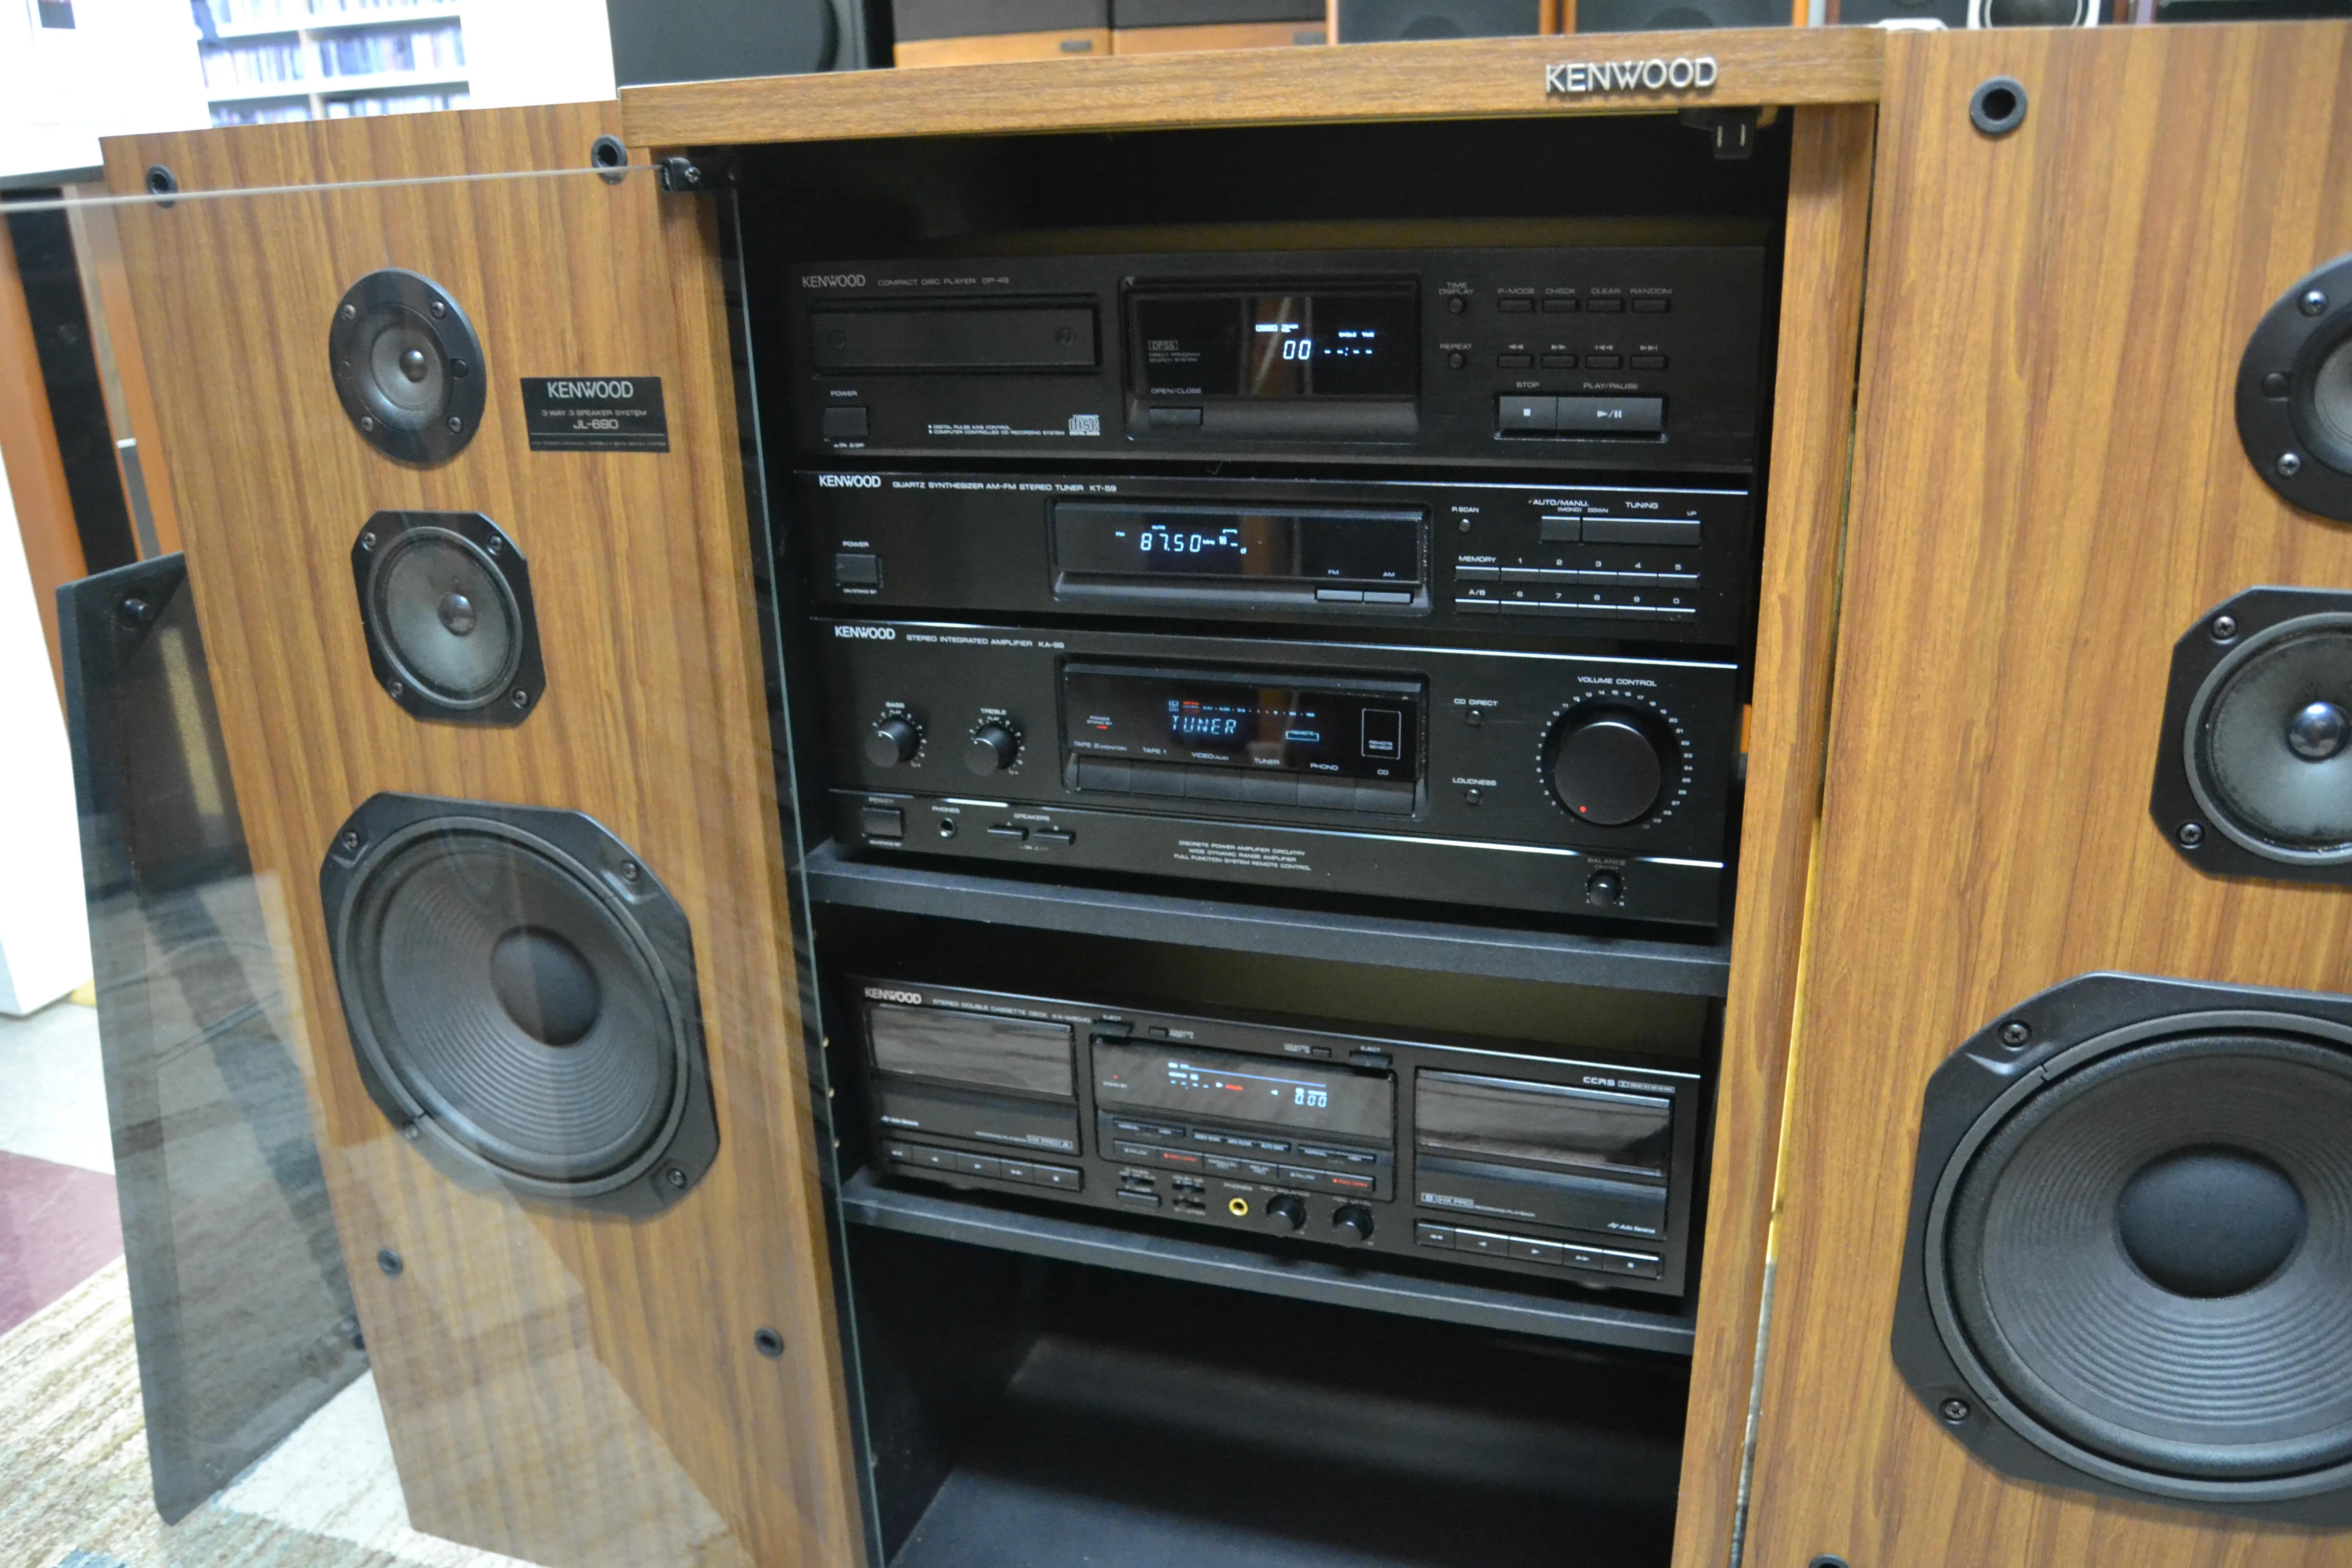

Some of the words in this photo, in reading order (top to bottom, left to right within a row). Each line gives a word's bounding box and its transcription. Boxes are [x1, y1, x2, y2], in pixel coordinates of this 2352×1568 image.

[1546, 57, 1718, 93] KENWOOD
[802, 275, 866, 288] KENWOOD
[1283, 340, 1311, 359] 00
[547, 381, 634, 398] KENWOOD
[573, 419, 619, 430] JL-690
[819, 475, 881, 488] KENWOOD
[928, 481, 984, 489] SYNTHESIZER
[1533, 499, 1589, 507] AUTO/MANU.
[1140, 533, 1202, 552] 87.50
[835, 626, 895, 641] KENWOOD
[940, 636, 988, 645] INTEGRATED
[991, 639, 1033, 647] AMPLIFIER
[1616, 678, 1657, 687] CONTROL
[1172, 716, 1237, 735] TUNER
[1191, 751, 1229, 761] VIDEO(AUX)
[1310, 763, 1338, 771] PHONO
[1453, 777, 1497, 786] LOUDNESS
[1013, 813, 1050, 821] SPEAKERS
[1272, 848, 1305, 856] CIRCUITRY
[865, 987, 922, 1004] KENWOOD
[1583, 1076, 1616, 1086] CCRS
